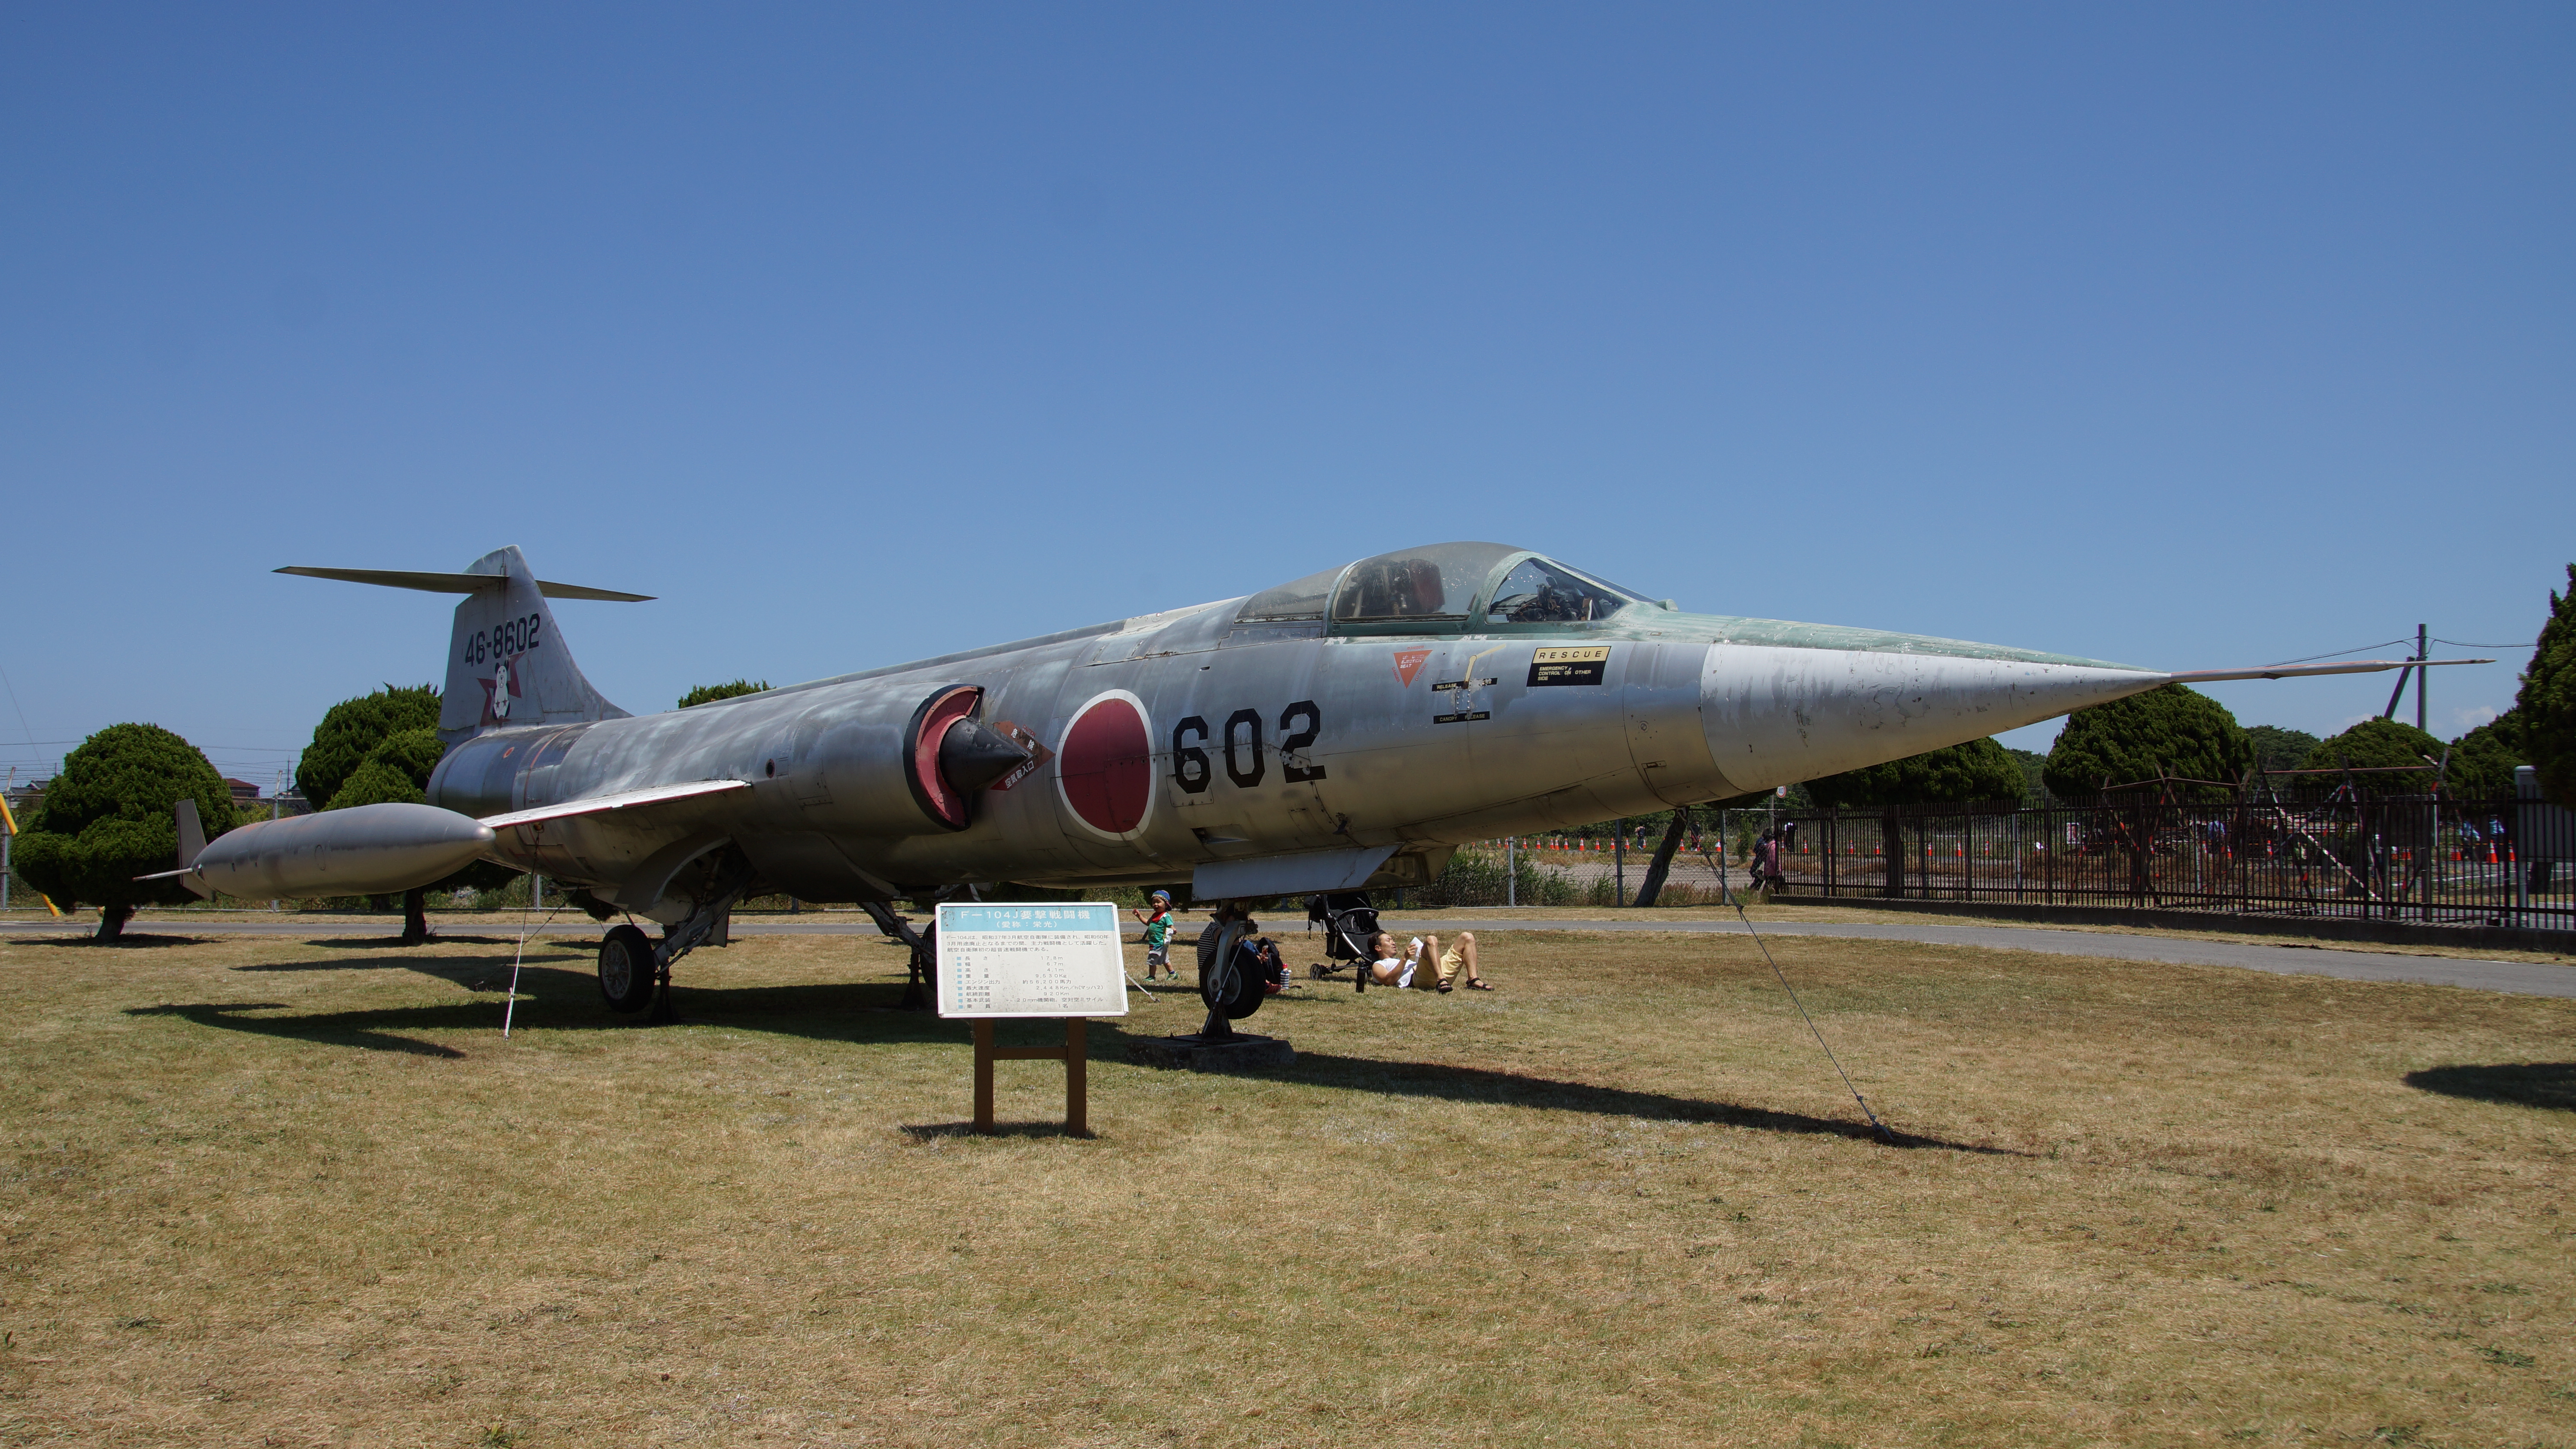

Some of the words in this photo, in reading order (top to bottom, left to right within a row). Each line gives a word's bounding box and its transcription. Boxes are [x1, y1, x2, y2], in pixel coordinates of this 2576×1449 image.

[465, 613, 541, 667] 46-8602
[1539, 651, 1602, 659] RESCUE
[1173, 700, 1327, 794] 602
[1005, 760, 1034, 789] 空気取入口
